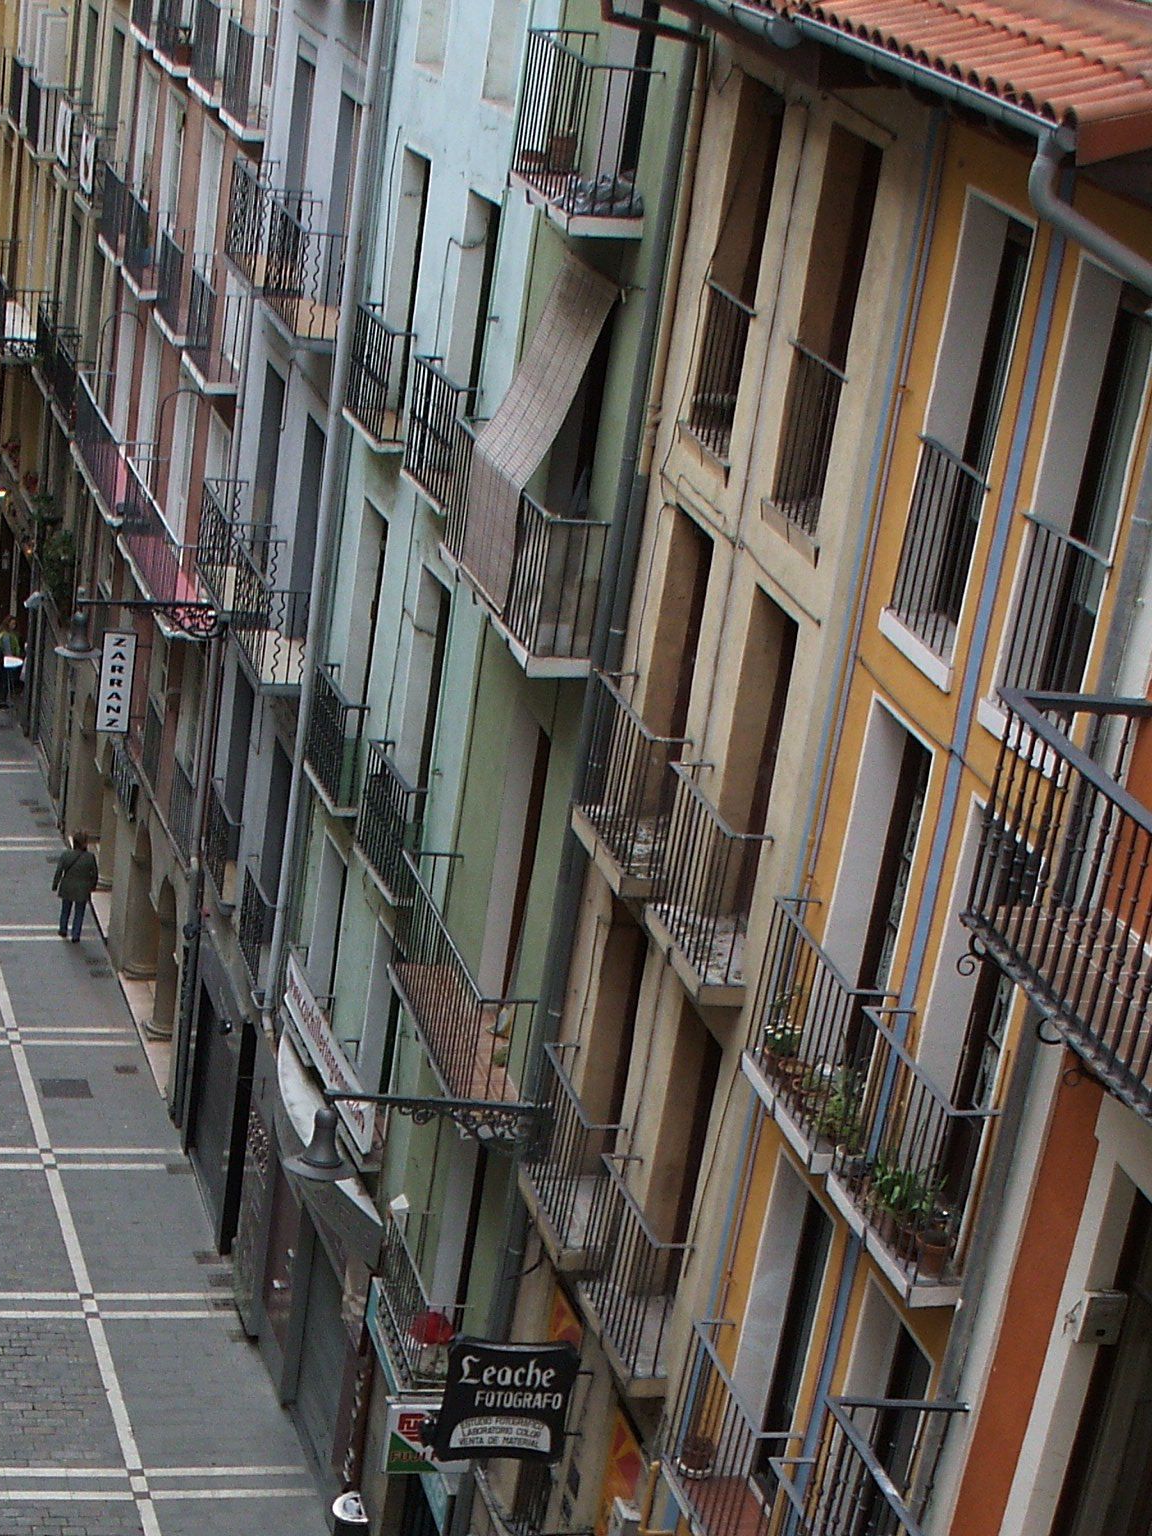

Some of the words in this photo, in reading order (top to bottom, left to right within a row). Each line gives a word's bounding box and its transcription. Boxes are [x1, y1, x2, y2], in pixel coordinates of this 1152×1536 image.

[105, 637, 127, 728] ZARRANZ
[458, 1354, 556, 1389] Leache
[474, 1390, 563, 1410] FOTOGRAFO
[458, 1437, 485, 1446] VENTA
[487, 1437, 499, 1445] DE
[502, 1437, 539, 1448] MATERIAL
[515, 1427, 542, 1438] COLOR
